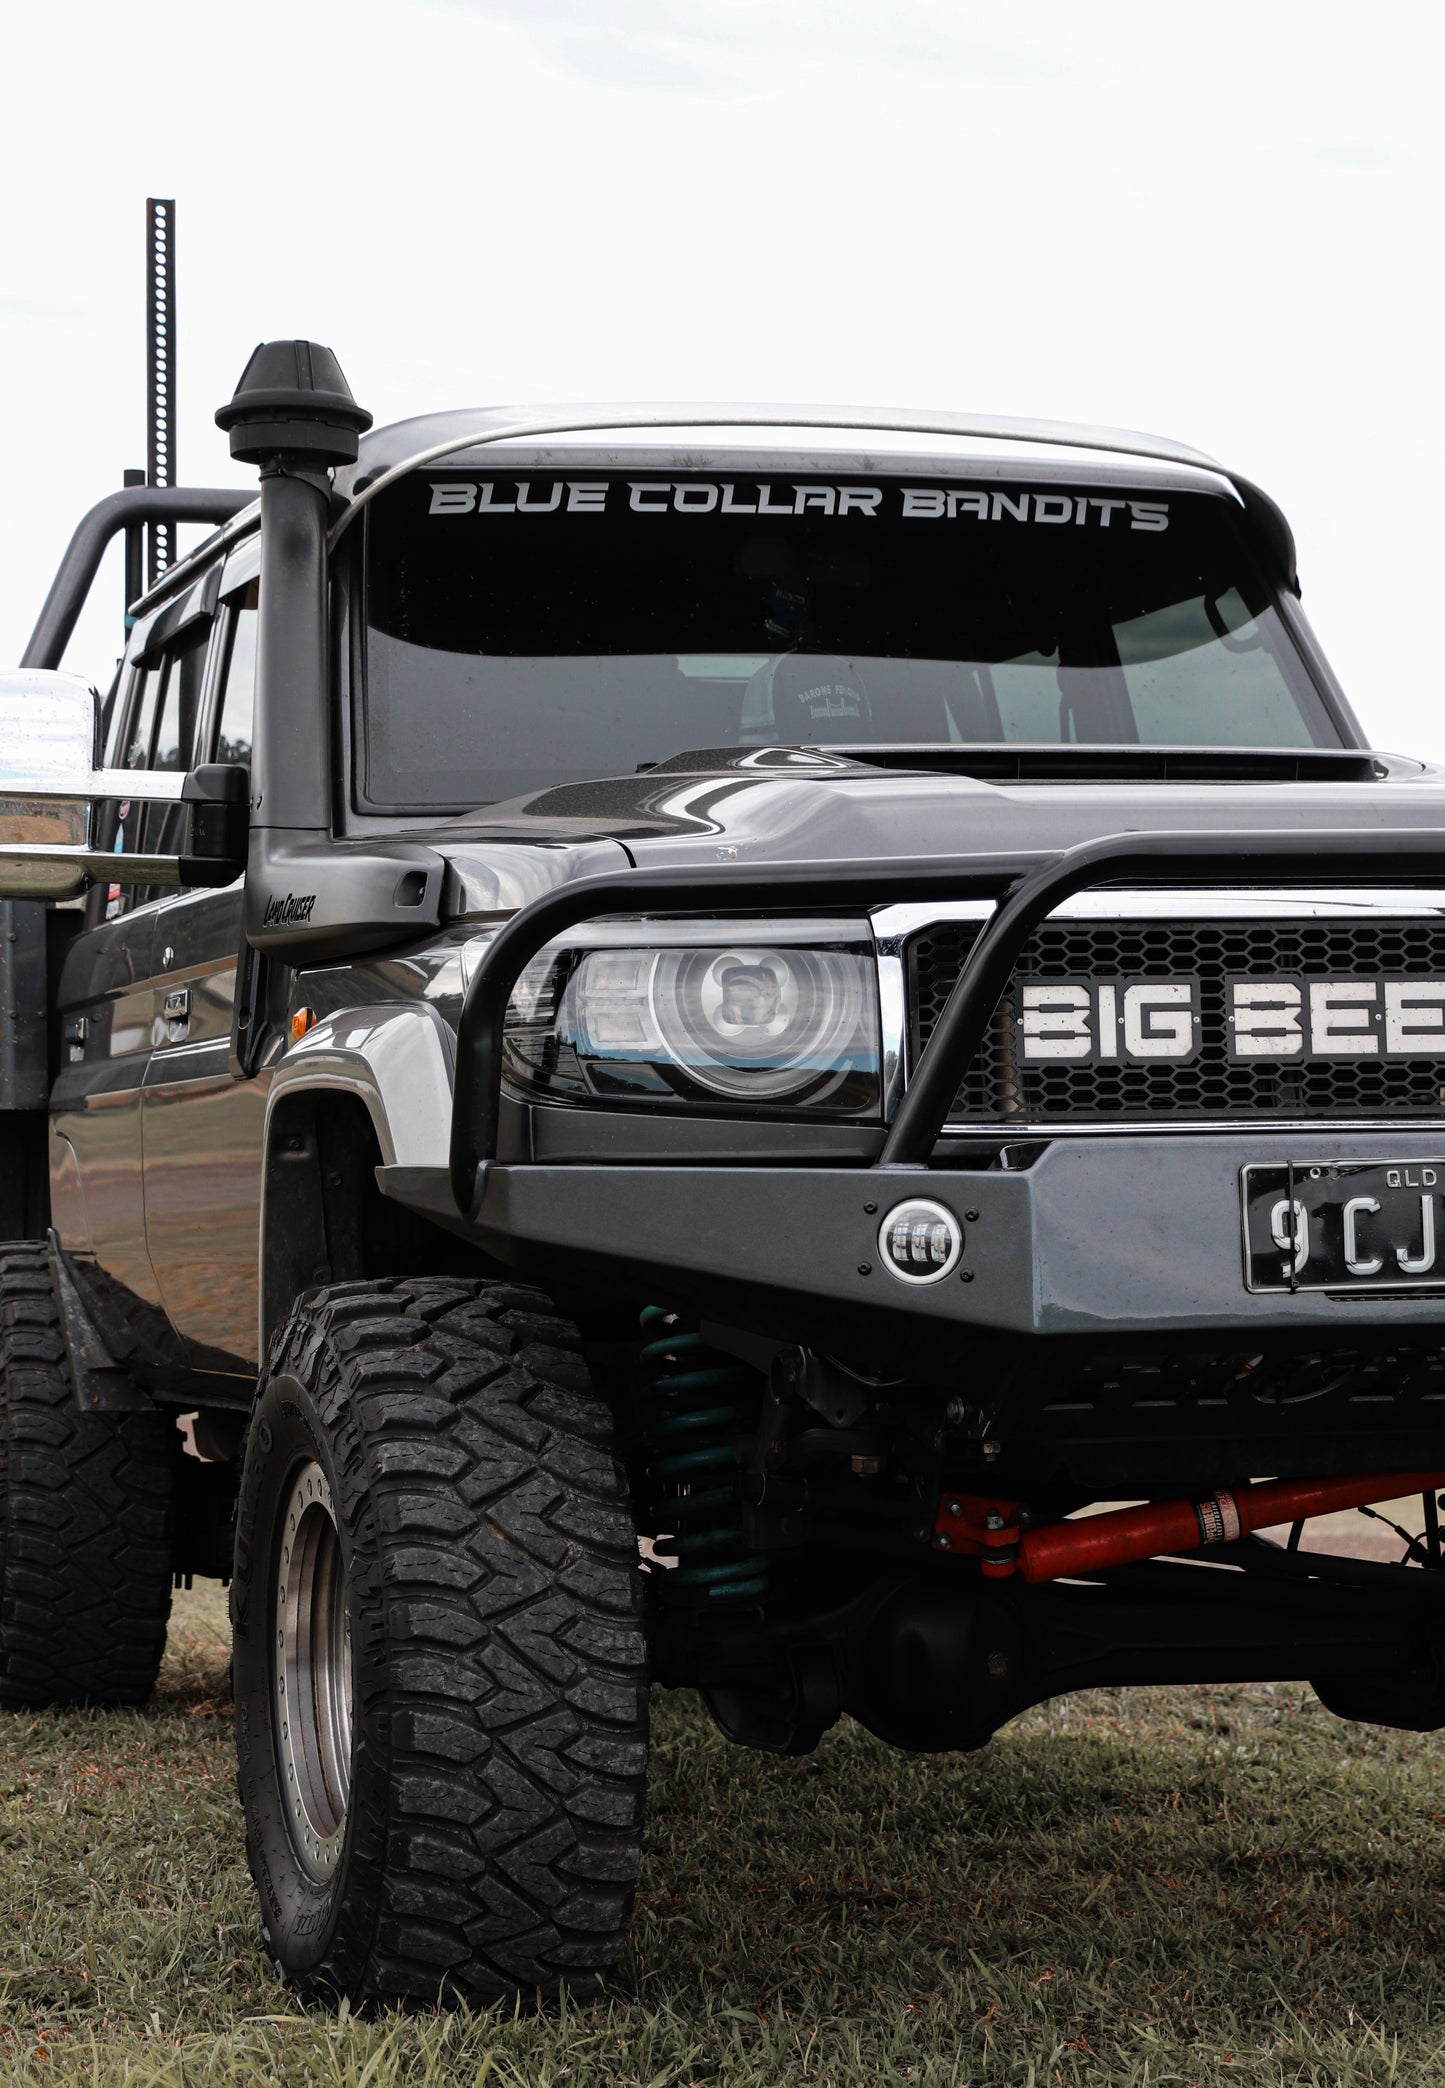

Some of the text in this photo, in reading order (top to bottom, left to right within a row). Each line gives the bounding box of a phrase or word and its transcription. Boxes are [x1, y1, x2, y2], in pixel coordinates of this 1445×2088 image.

[429, 482, 1169, 532] BLUE COLLAR BANDITS
[798, 684, 831, 704] BARONS
[1022, 982, 1193, 1059] BIG
[1386, 1169, 1438, 1188] QLD
